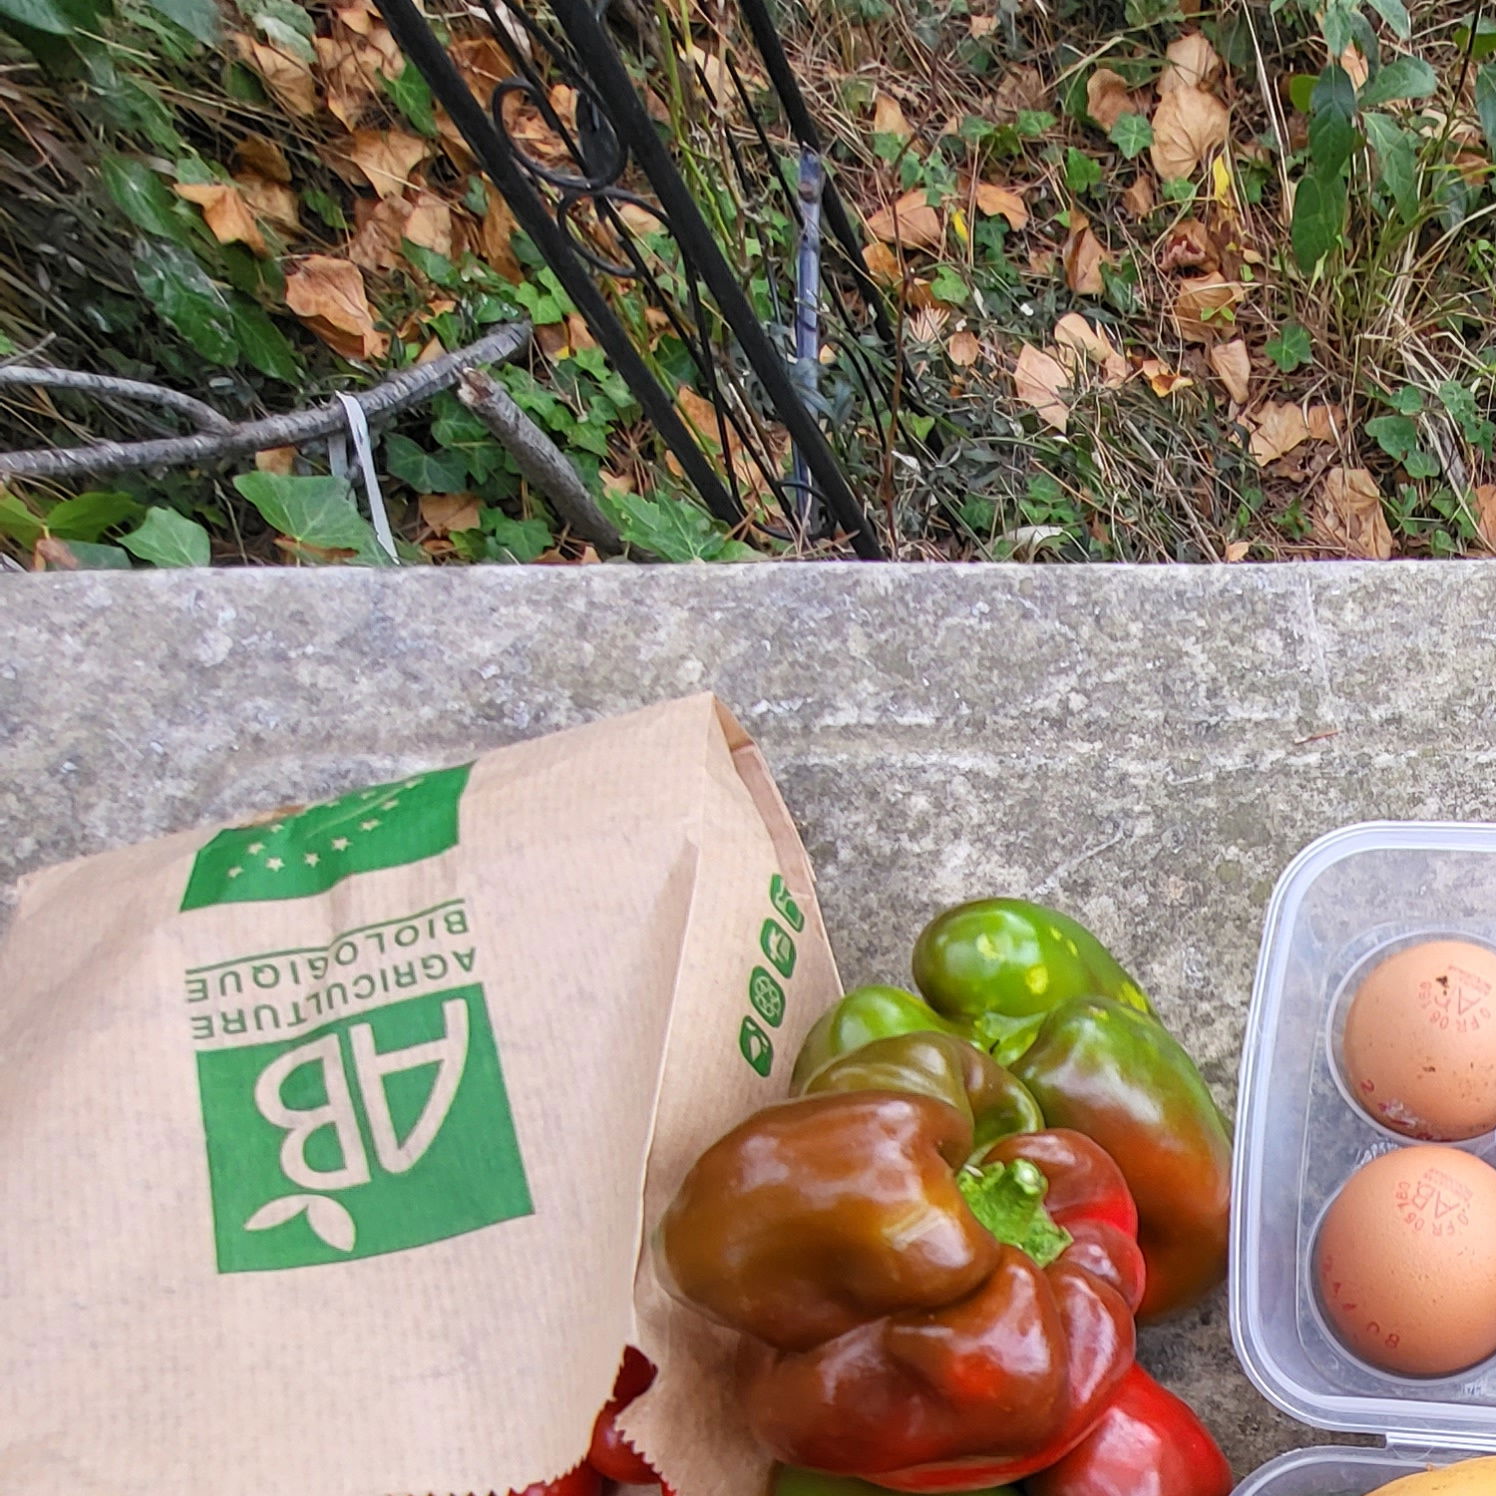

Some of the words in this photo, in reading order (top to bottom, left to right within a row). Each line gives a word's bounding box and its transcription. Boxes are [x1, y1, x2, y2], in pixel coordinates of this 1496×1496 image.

[185, 909, 469, 1002] BIOLOGIQUE
[190, 947, 476, 1040] AGRICULTURE
[254, 997, 470, 1191] AB
[1412, 1183, 1461, 1219] AB
